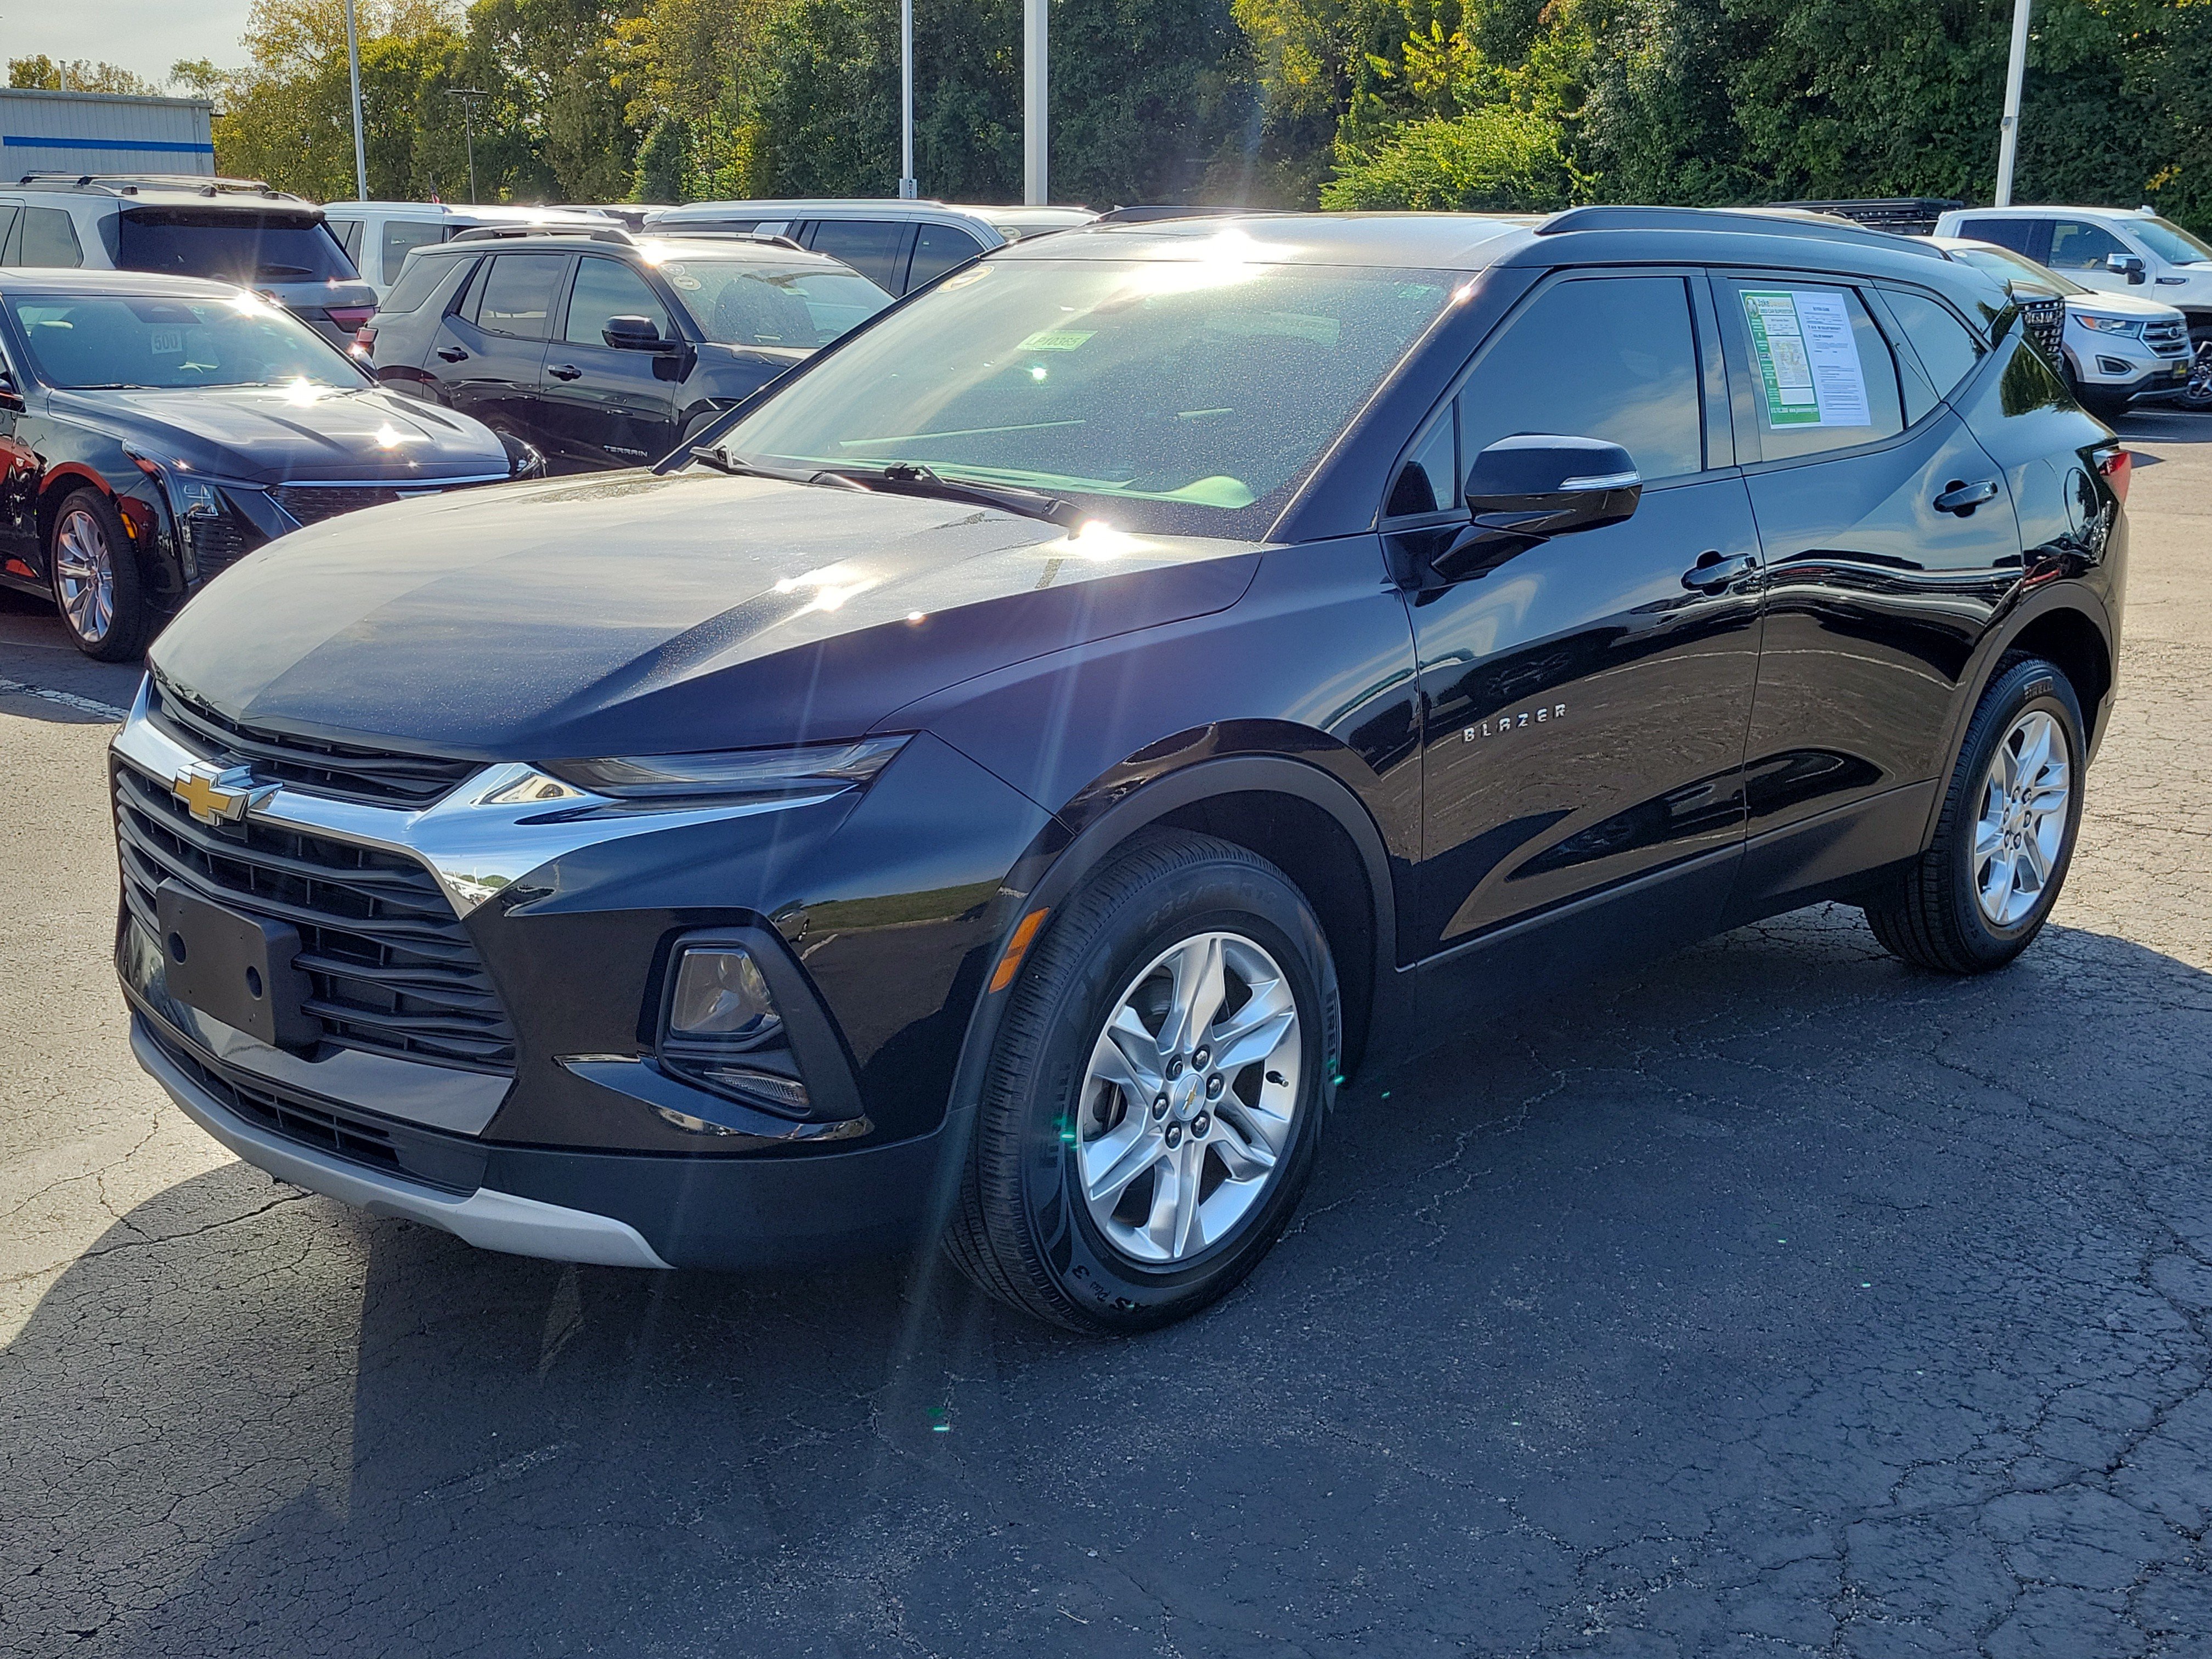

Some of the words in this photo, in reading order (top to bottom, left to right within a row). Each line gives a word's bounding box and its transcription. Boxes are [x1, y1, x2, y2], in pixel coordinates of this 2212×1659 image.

[154, 334, 178, 350] 500
[603, 445, 648, 457] TERRAIN
[1463, 703, 1567, 743] BLAZER
[1071, 1265, 1090, 1280] 3
